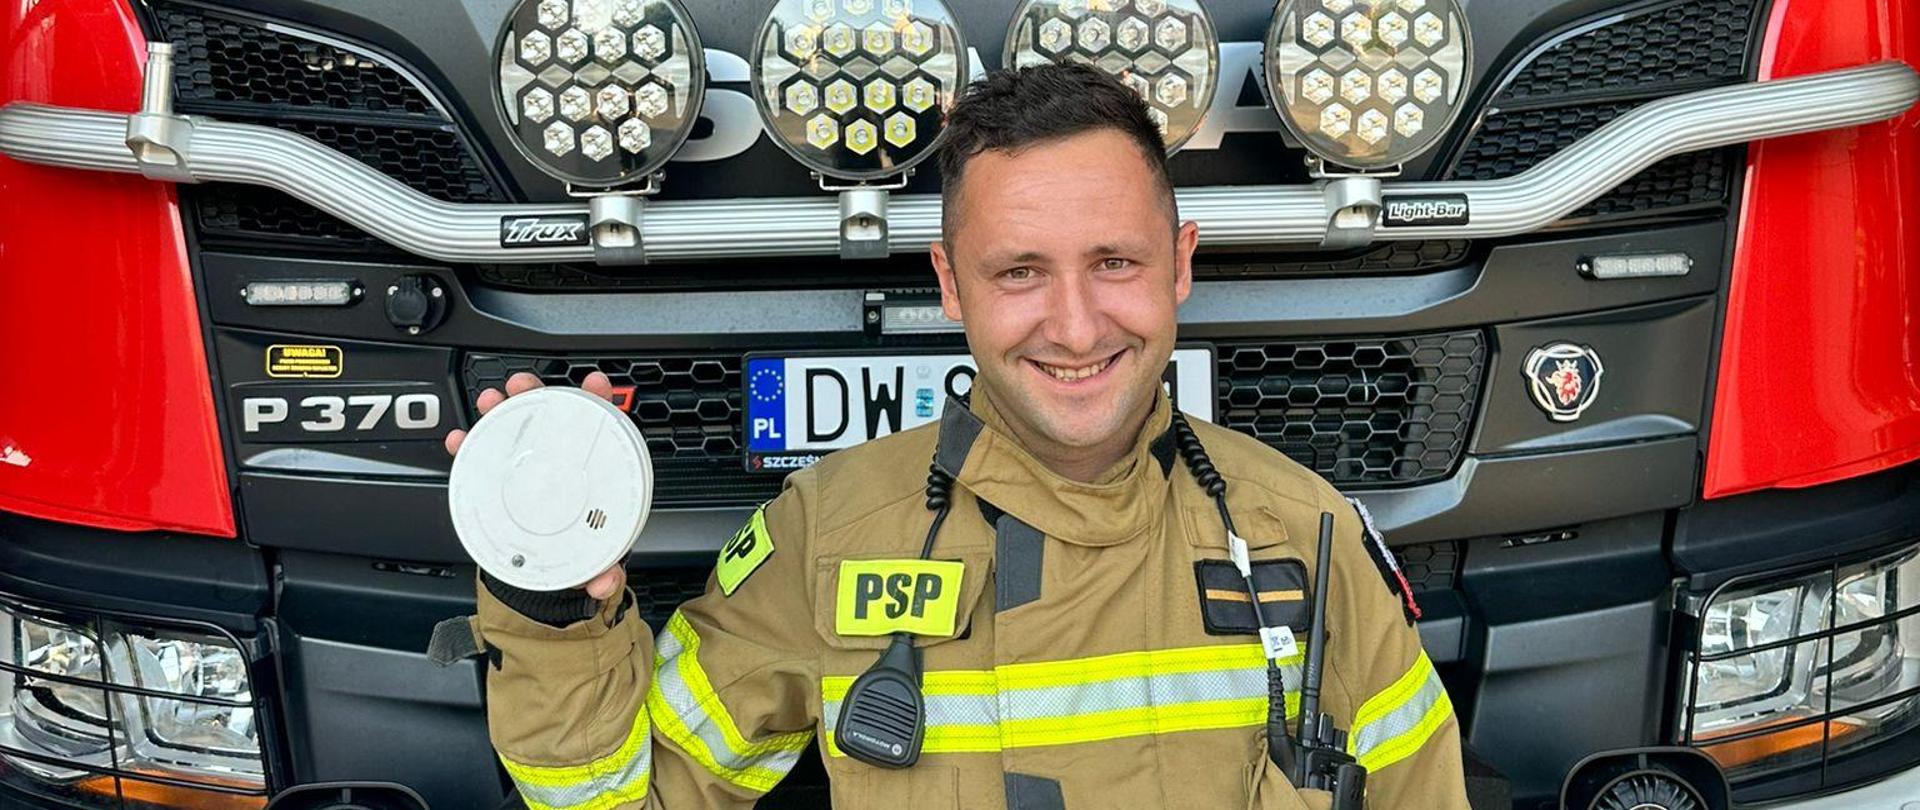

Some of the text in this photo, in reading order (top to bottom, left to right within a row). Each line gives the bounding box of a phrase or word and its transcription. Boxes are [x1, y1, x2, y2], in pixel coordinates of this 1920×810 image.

[1389, 202, 1467, 222] Light-Bar
[505, 218, 584, 242] Trux
[243, 394, 440, 432] P 370
[806, 366, 904, 442] DW
[754, 418, 781, 438] PL
[854, 573, 942, 618] PSP
